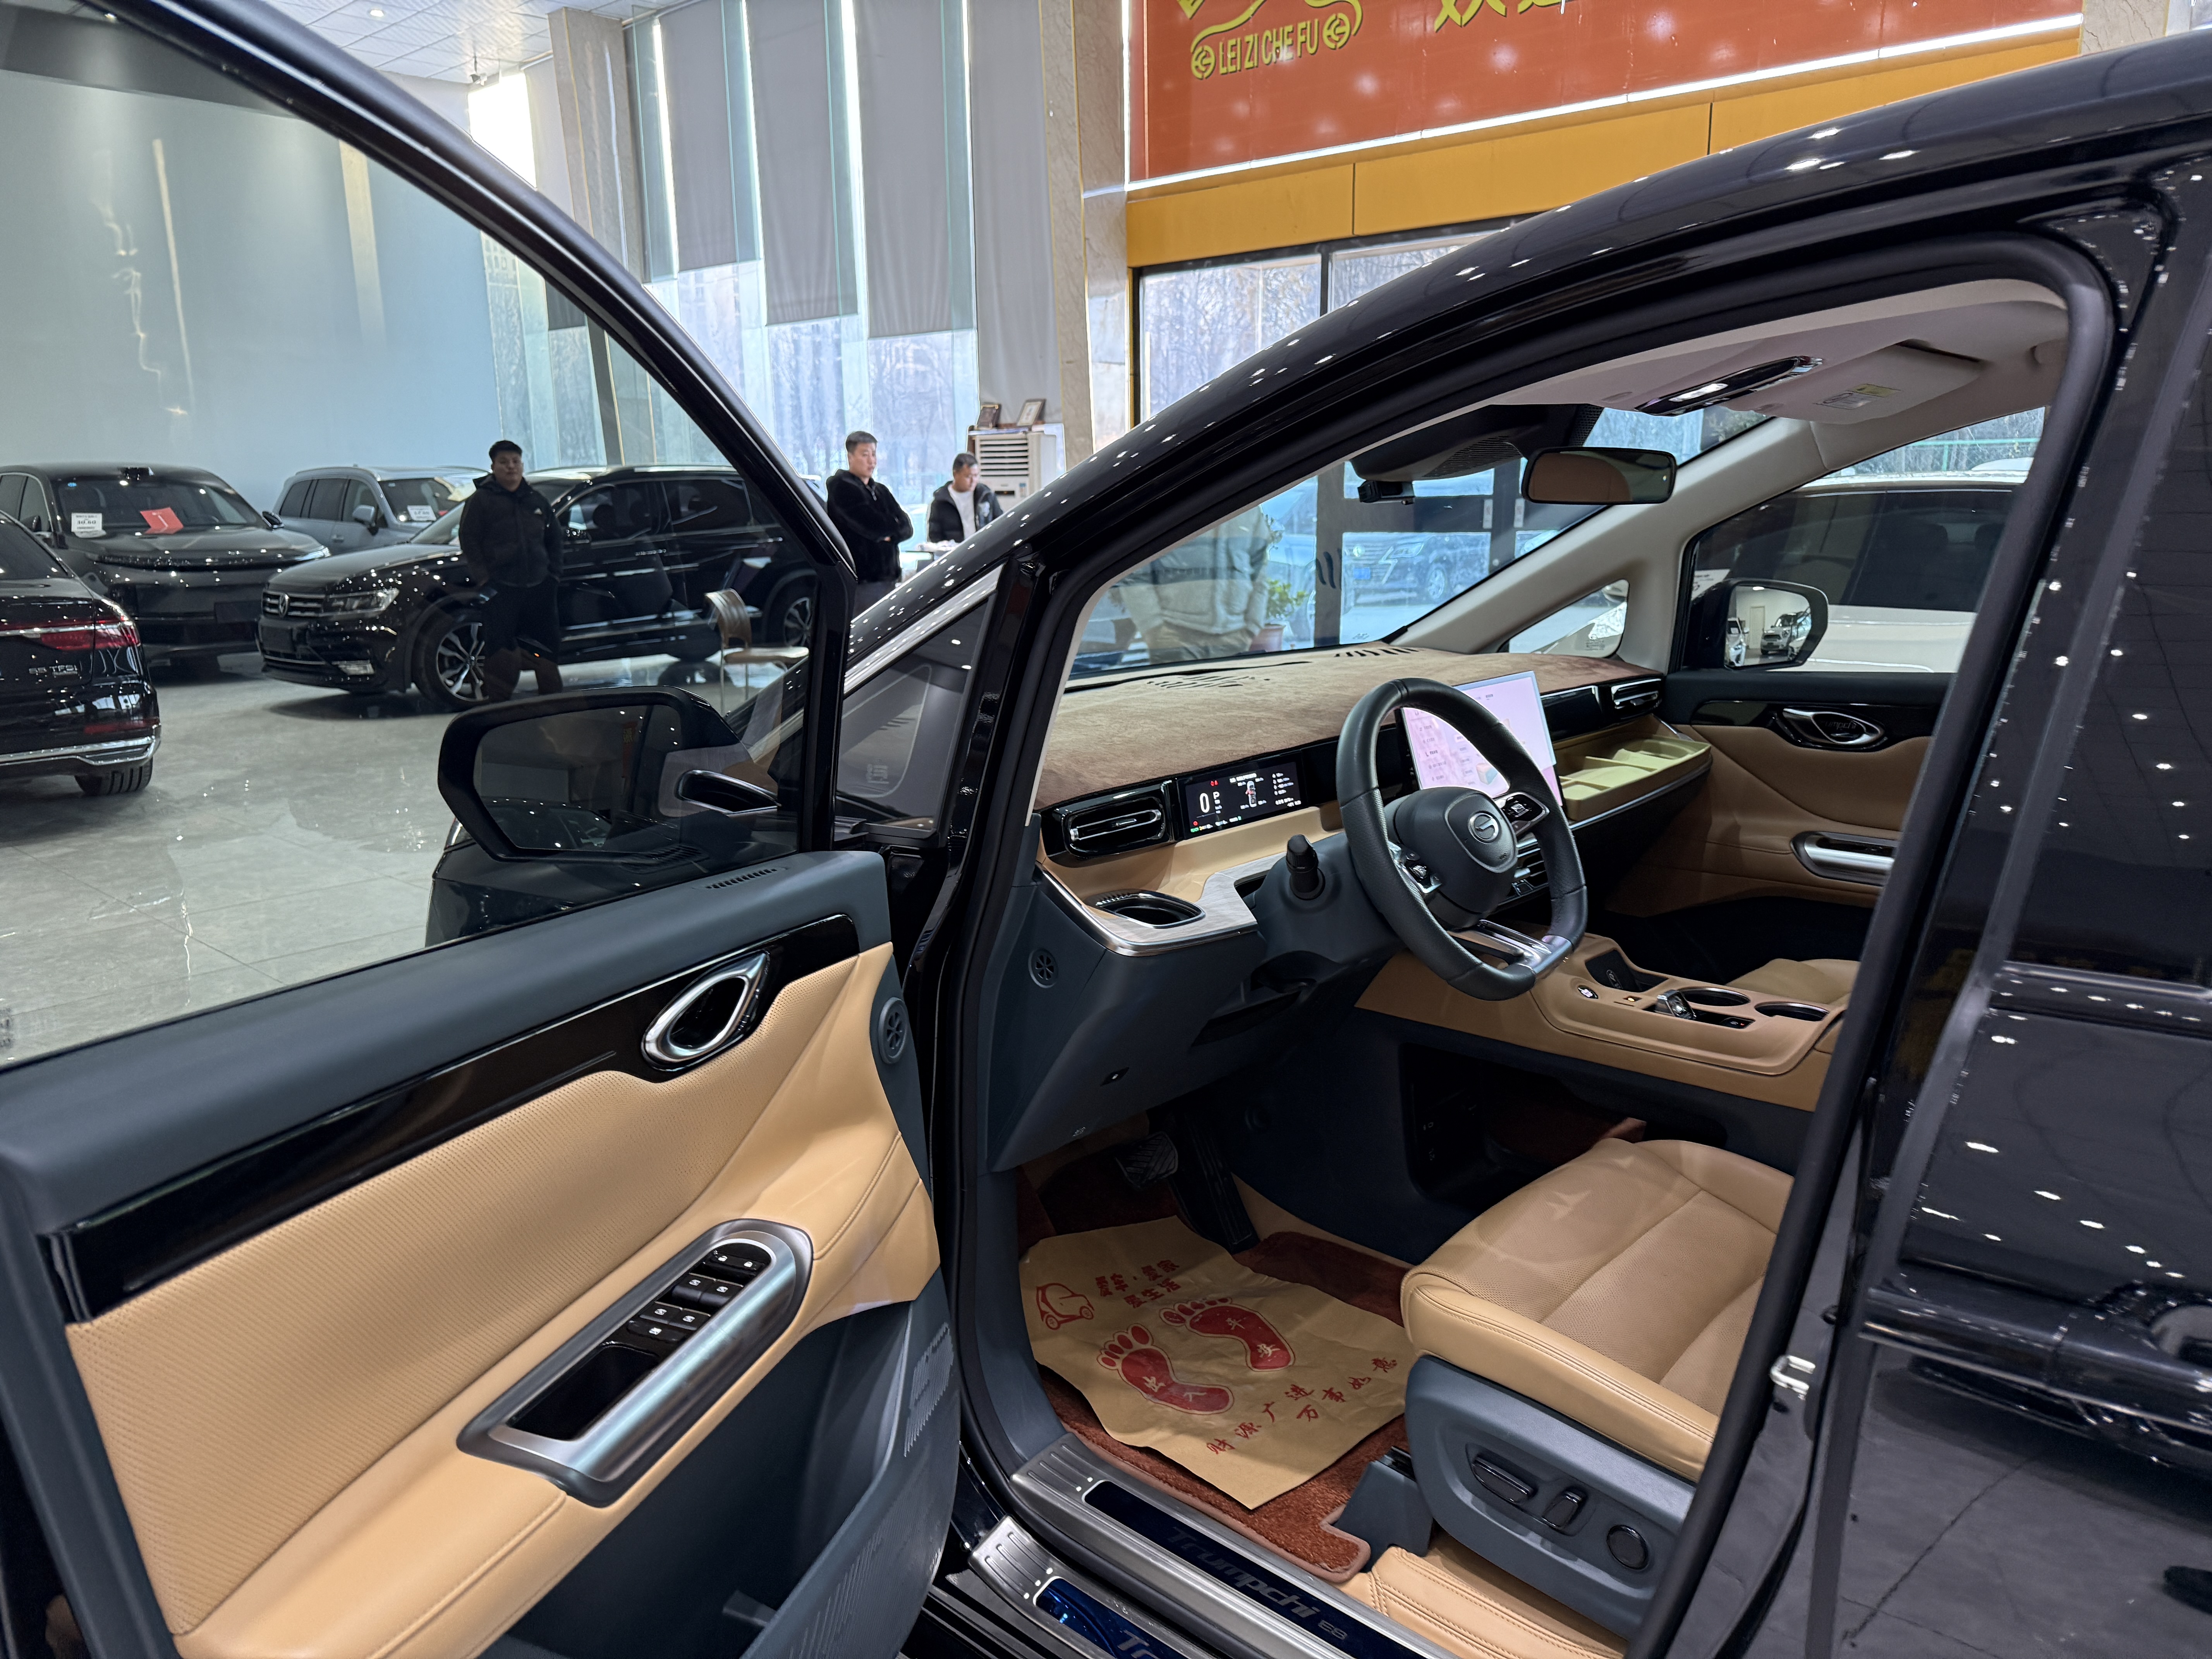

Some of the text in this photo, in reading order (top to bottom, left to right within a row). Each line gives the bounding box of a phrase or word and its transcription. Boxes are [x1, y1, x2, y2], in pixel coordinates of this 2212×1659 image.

[1219, 19, 1319, 75] LEI ZI CHE FU
[1213, 791, 1220, 799] P
[1168, 1526, 1321, 1618] Trumpchi
